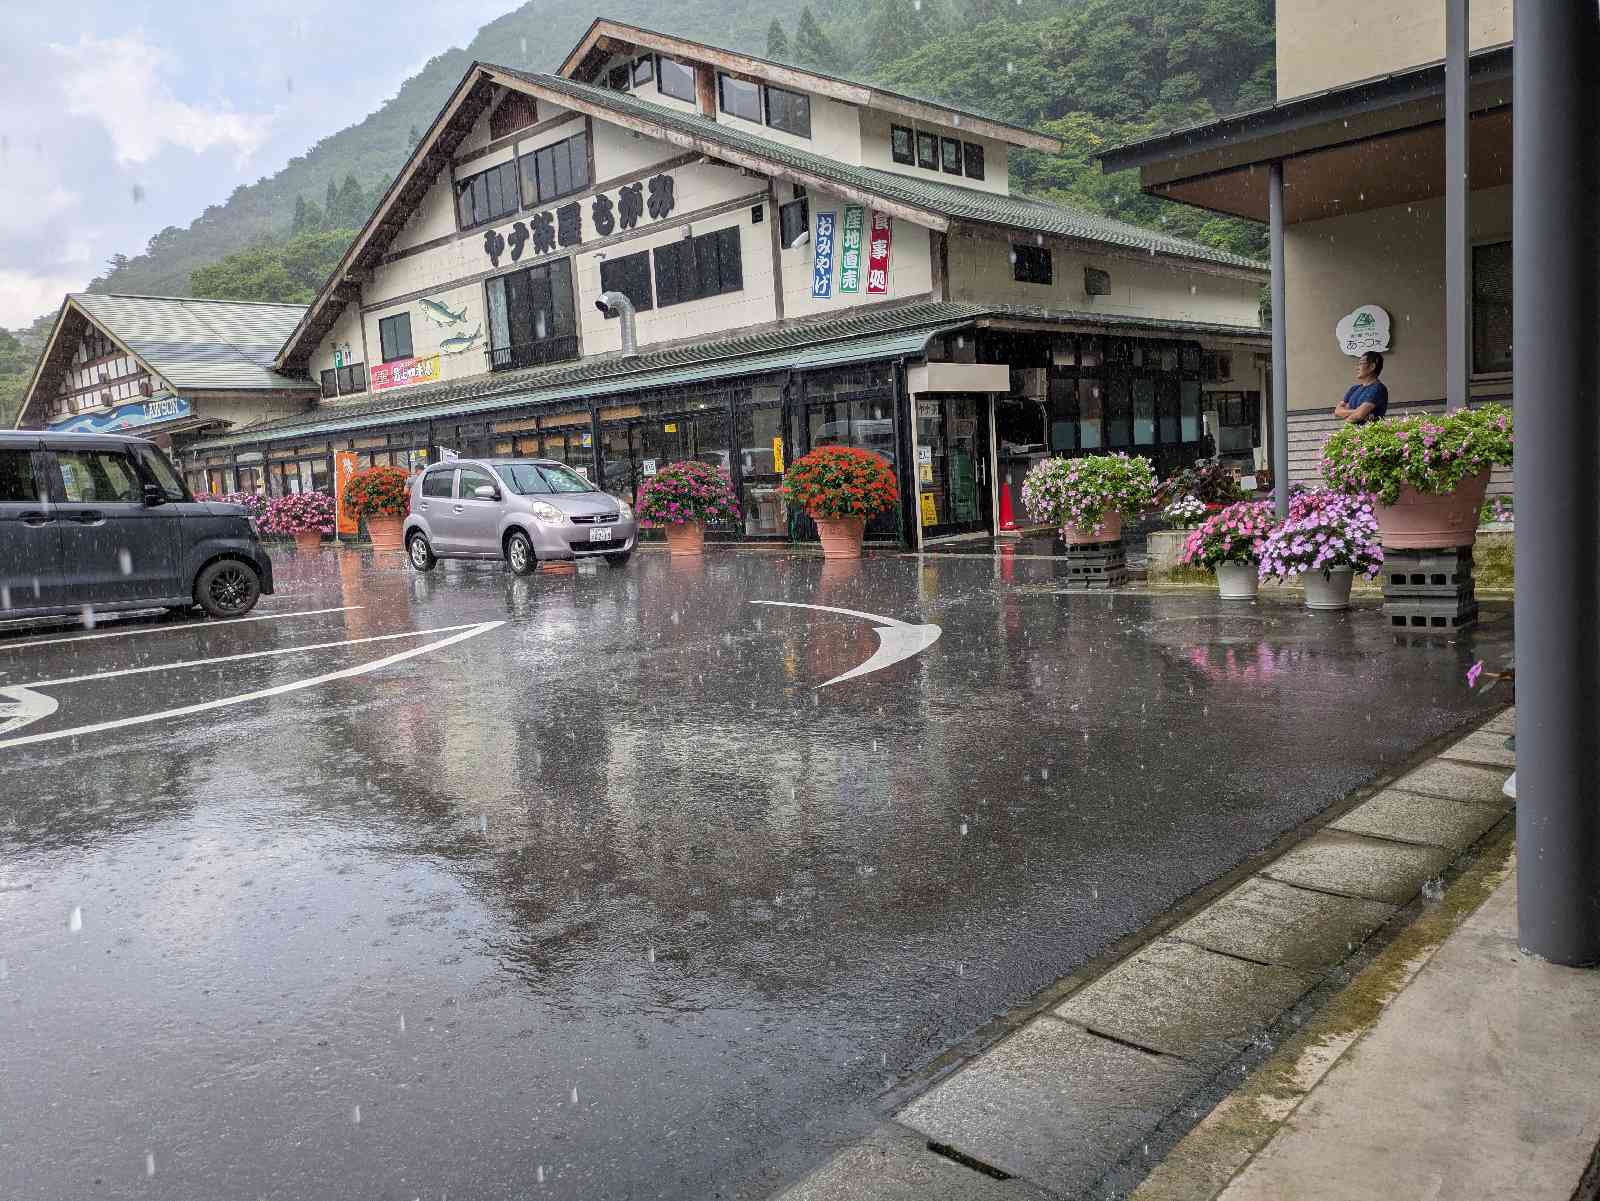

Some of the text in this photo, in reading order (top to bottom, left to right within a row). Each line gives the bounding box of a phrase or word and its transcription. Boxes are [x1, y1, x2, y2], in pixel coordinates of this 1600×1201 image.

[815, 217, 832, 294] おみやげ
[842, 209, 862, 289] 産地直売
[143, 399, 178, 418] LAWSON
